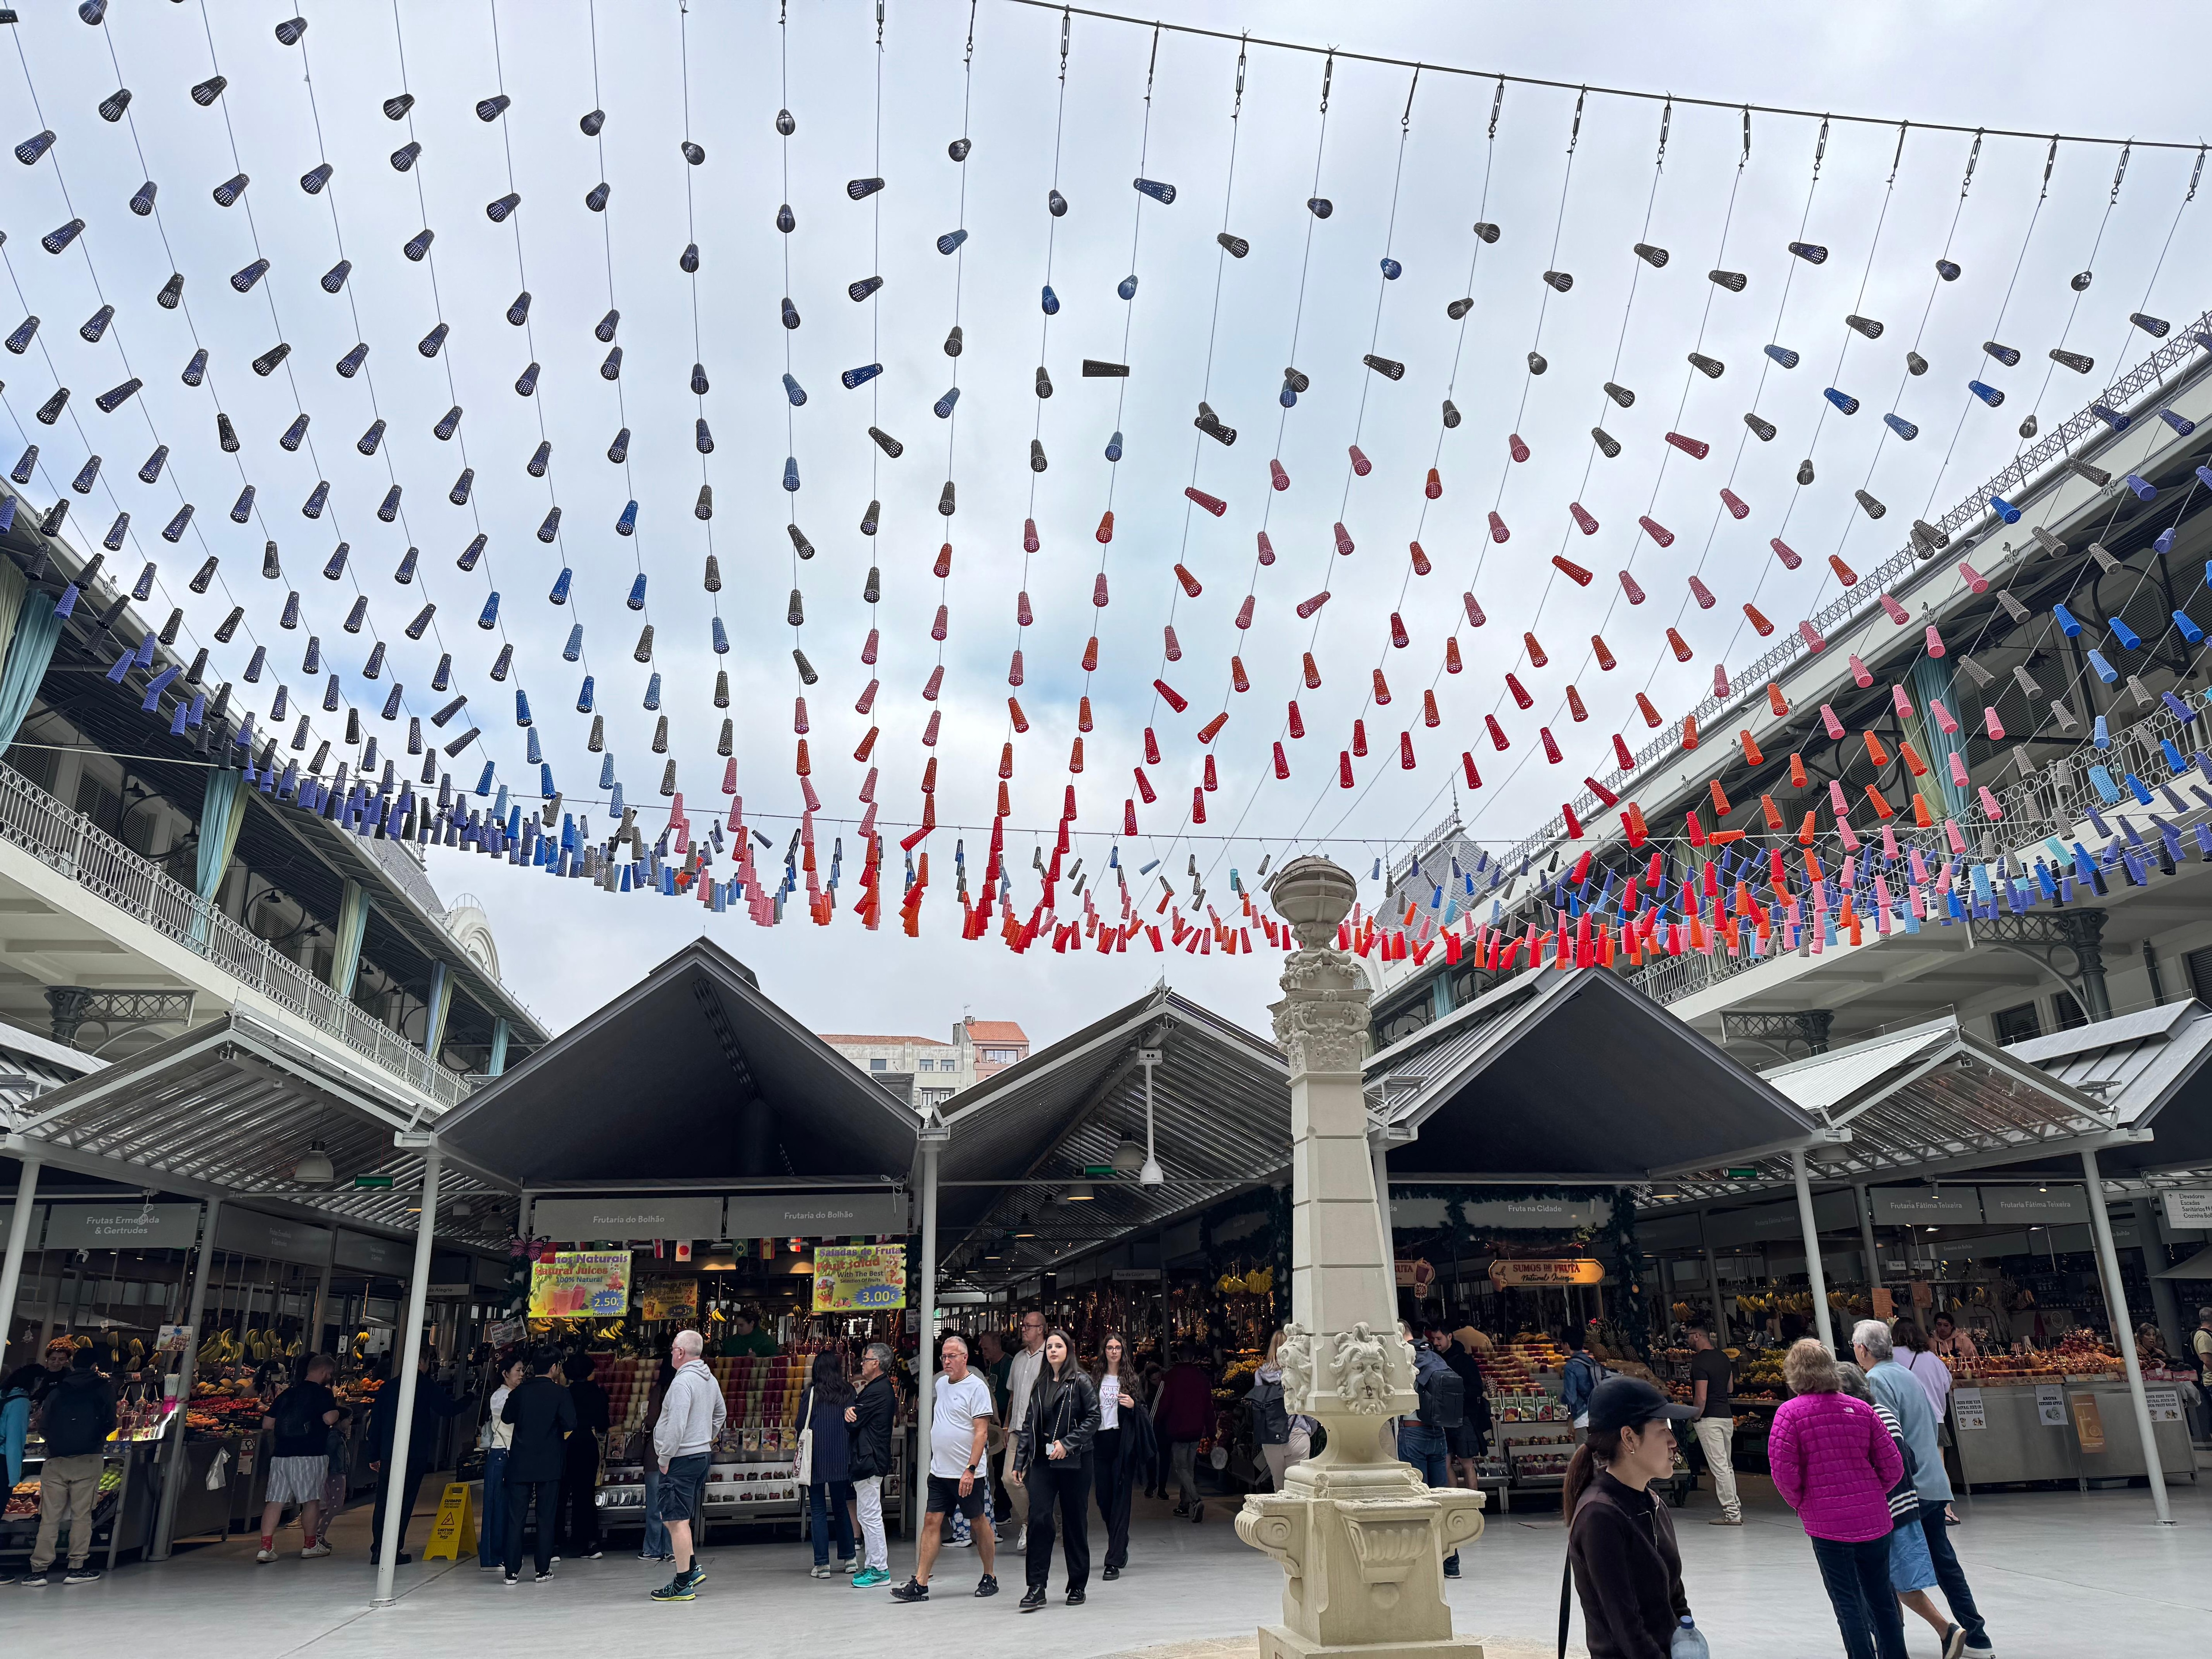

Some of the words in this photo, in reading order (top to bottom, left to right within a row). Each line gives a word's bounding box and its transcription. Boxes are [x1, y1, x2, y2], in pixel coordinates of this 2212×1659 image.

[819, 1248, 857, 1257] Saladas
[860, 1247, 872, 1256] de
[876, 1247, 901, 1255] Fruta
[576, 1253, 628, 1264] Naturais
[817, 1261, 845, 1272] Fruit
[849, 1256, 880, 1269] salad
[1554, 1263, 1581, 1273] FRUTA
[535, 1267, 573, 1275] Natural
[576, 1266, 608, 1275] Juices
